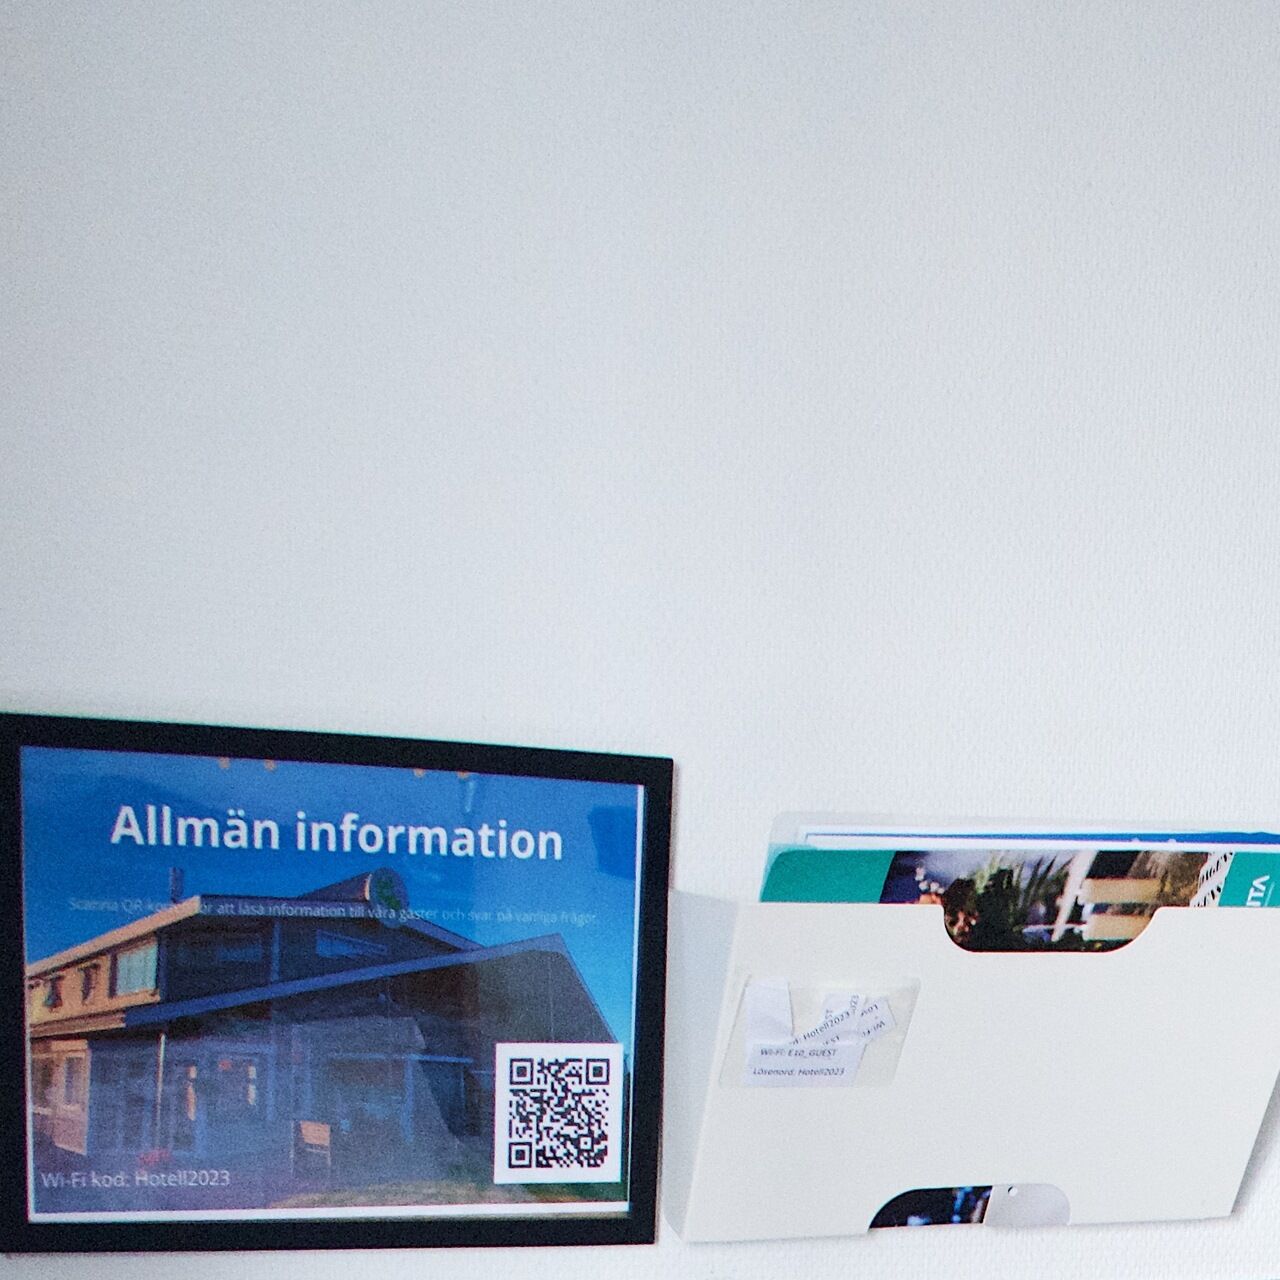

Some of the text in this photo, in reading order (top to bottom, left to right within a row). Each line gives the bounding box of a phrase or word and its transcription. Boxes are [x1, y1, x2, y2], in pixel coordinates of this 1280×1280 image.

[111, 804, 562, 861] Allmän information
[217, 903, 235, 915] att
[269, 902, 346, 917] information
[350, 904, 364, 918] till
[369, 903, 396, 919] våra
[441, 908, 465, 921] och
[798, 1067, 846, 1076] Hotell2023
[40, 1169, 231, 1188] Wi-Fi kod: Hotell2023
